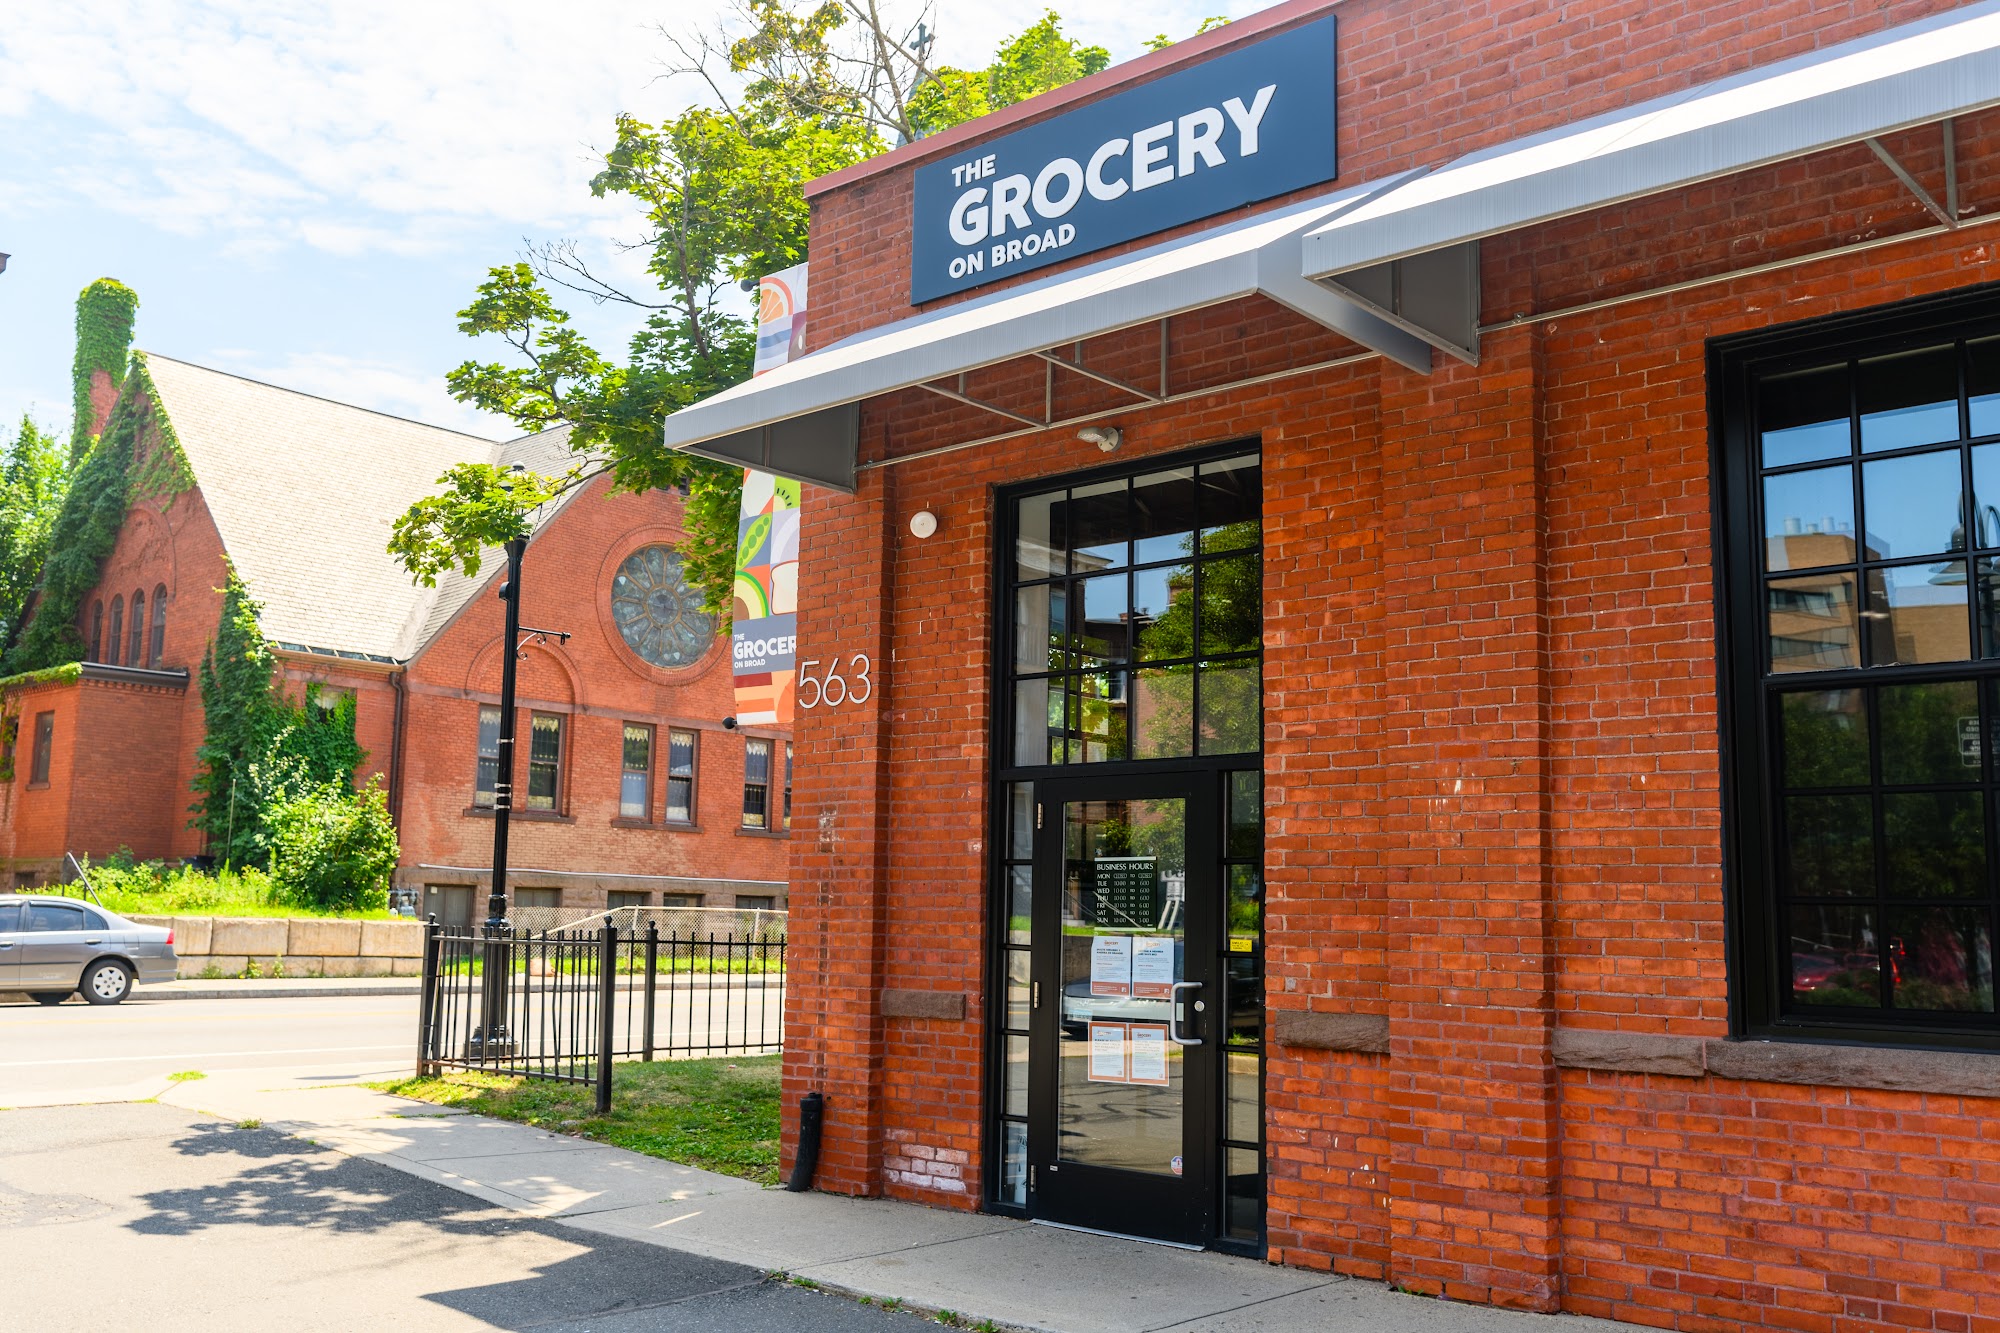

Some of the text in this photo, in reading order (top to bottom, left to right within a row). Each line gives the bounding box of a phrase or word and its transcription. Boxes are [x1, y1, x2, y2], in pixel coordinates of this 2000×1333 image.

[948, 83, 1277, 246] GROCERY
[951, 153, 996, 188] THE
[948, 223, 1076, 279] ON BROAD
[734, 633, 745, 641] THE
[734, 658, 766, 669] ON BROAD
[798, 653, 871, 709] 563
[1097, 862, 1154, 871] BUSINESS HOURS
